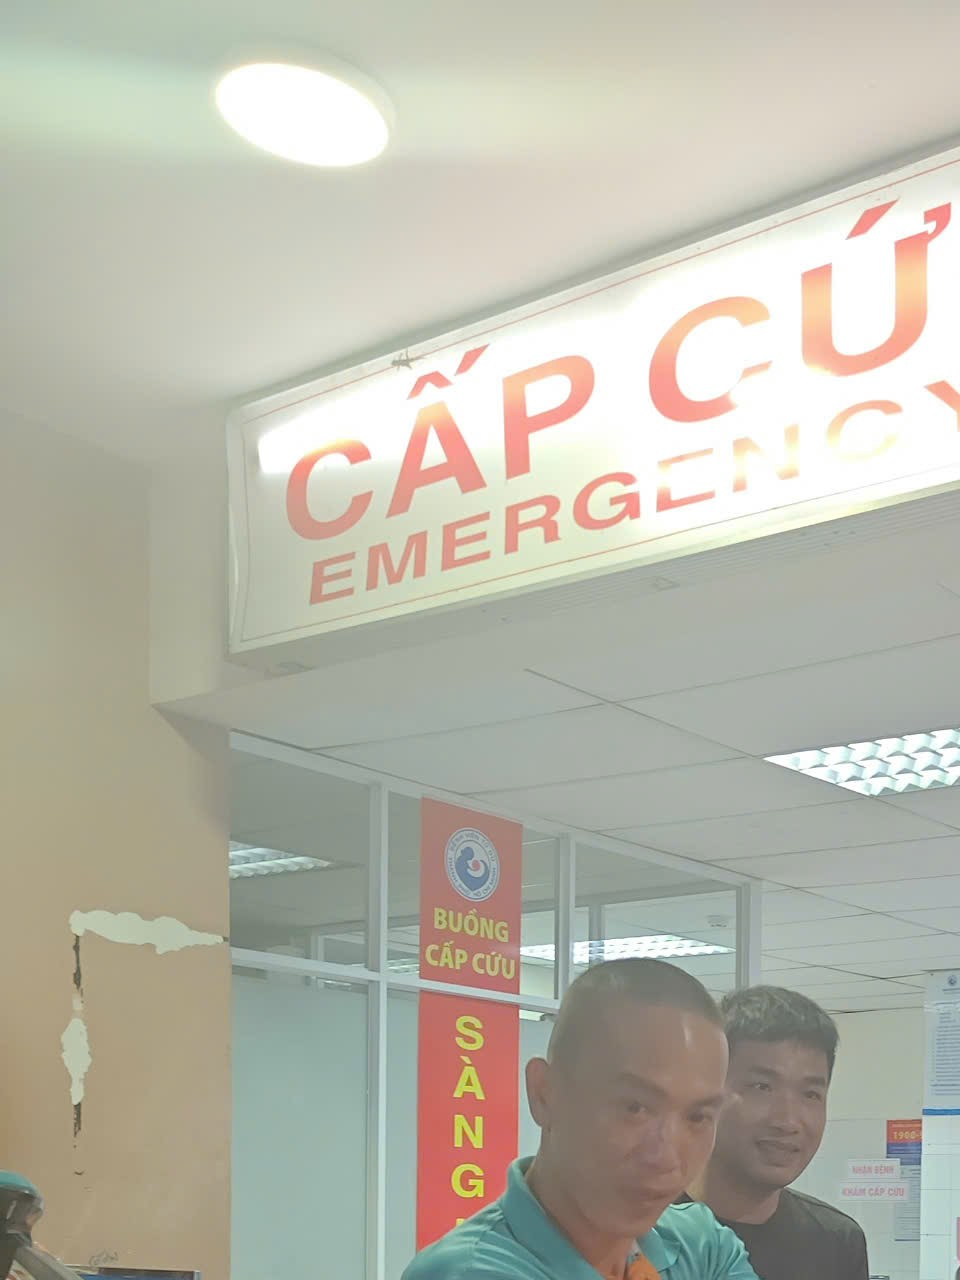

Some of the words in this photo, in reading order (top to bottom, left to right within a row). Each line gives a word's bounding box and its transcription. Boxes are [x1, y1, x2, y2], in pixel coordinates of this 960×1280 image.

[285, 343, 596, 541] CẤP
[434, 907, 509, 943] BUỒNG
[425, 940, 468, 970] CẤP
[472, 951, 515, 979] CỨU
